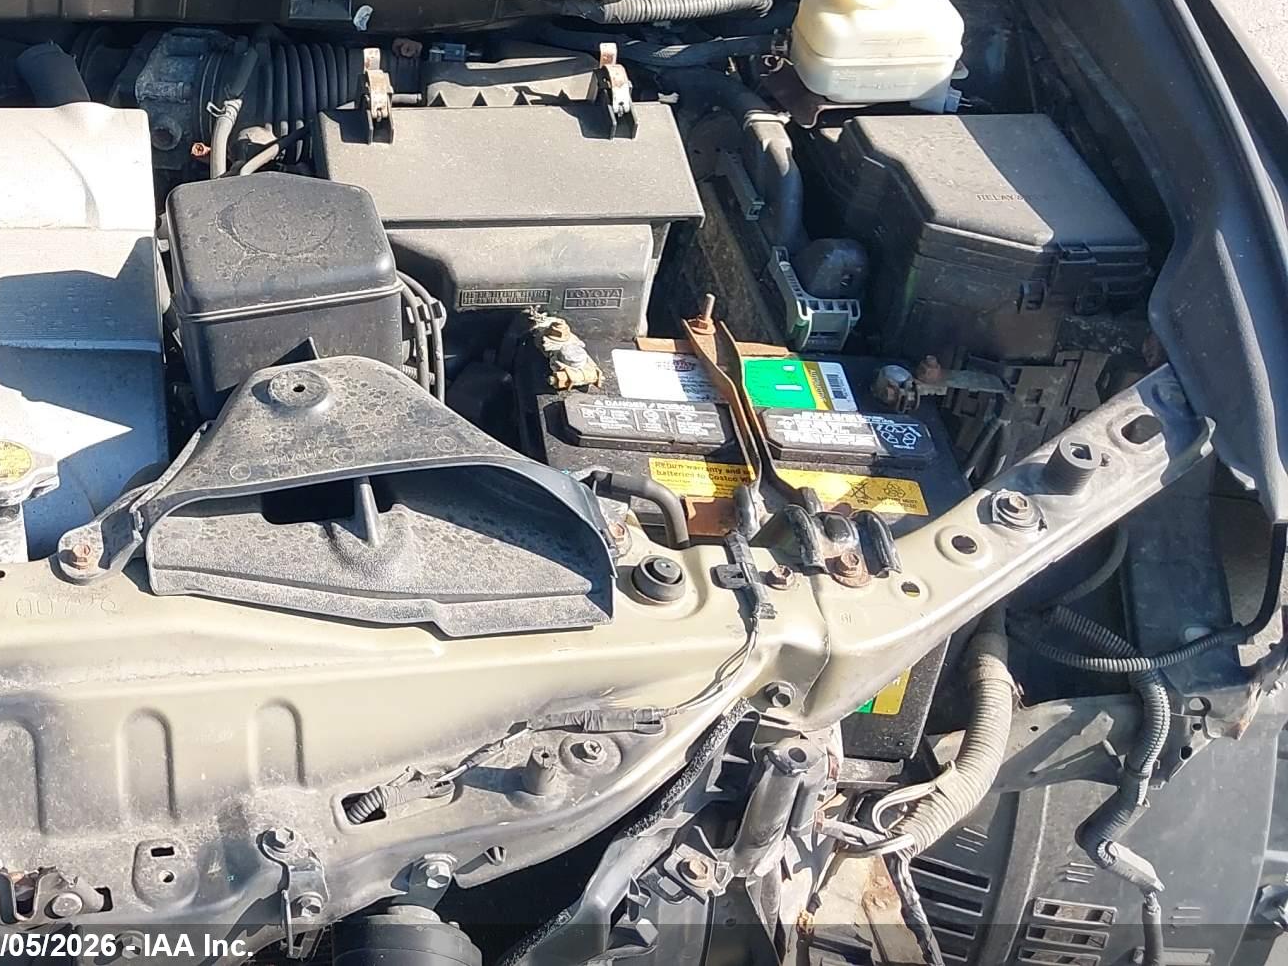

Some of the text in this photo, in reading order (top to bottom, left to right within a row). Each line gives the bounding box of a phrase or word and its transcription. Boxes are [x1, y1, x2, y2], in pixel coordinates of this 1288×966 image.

[976, 194, 1014, 202] RELAY
[568, 289, 620, 298] TOYOTA
[726, 467, 741, 475] and
[709, 473, 738, 482] Costco
